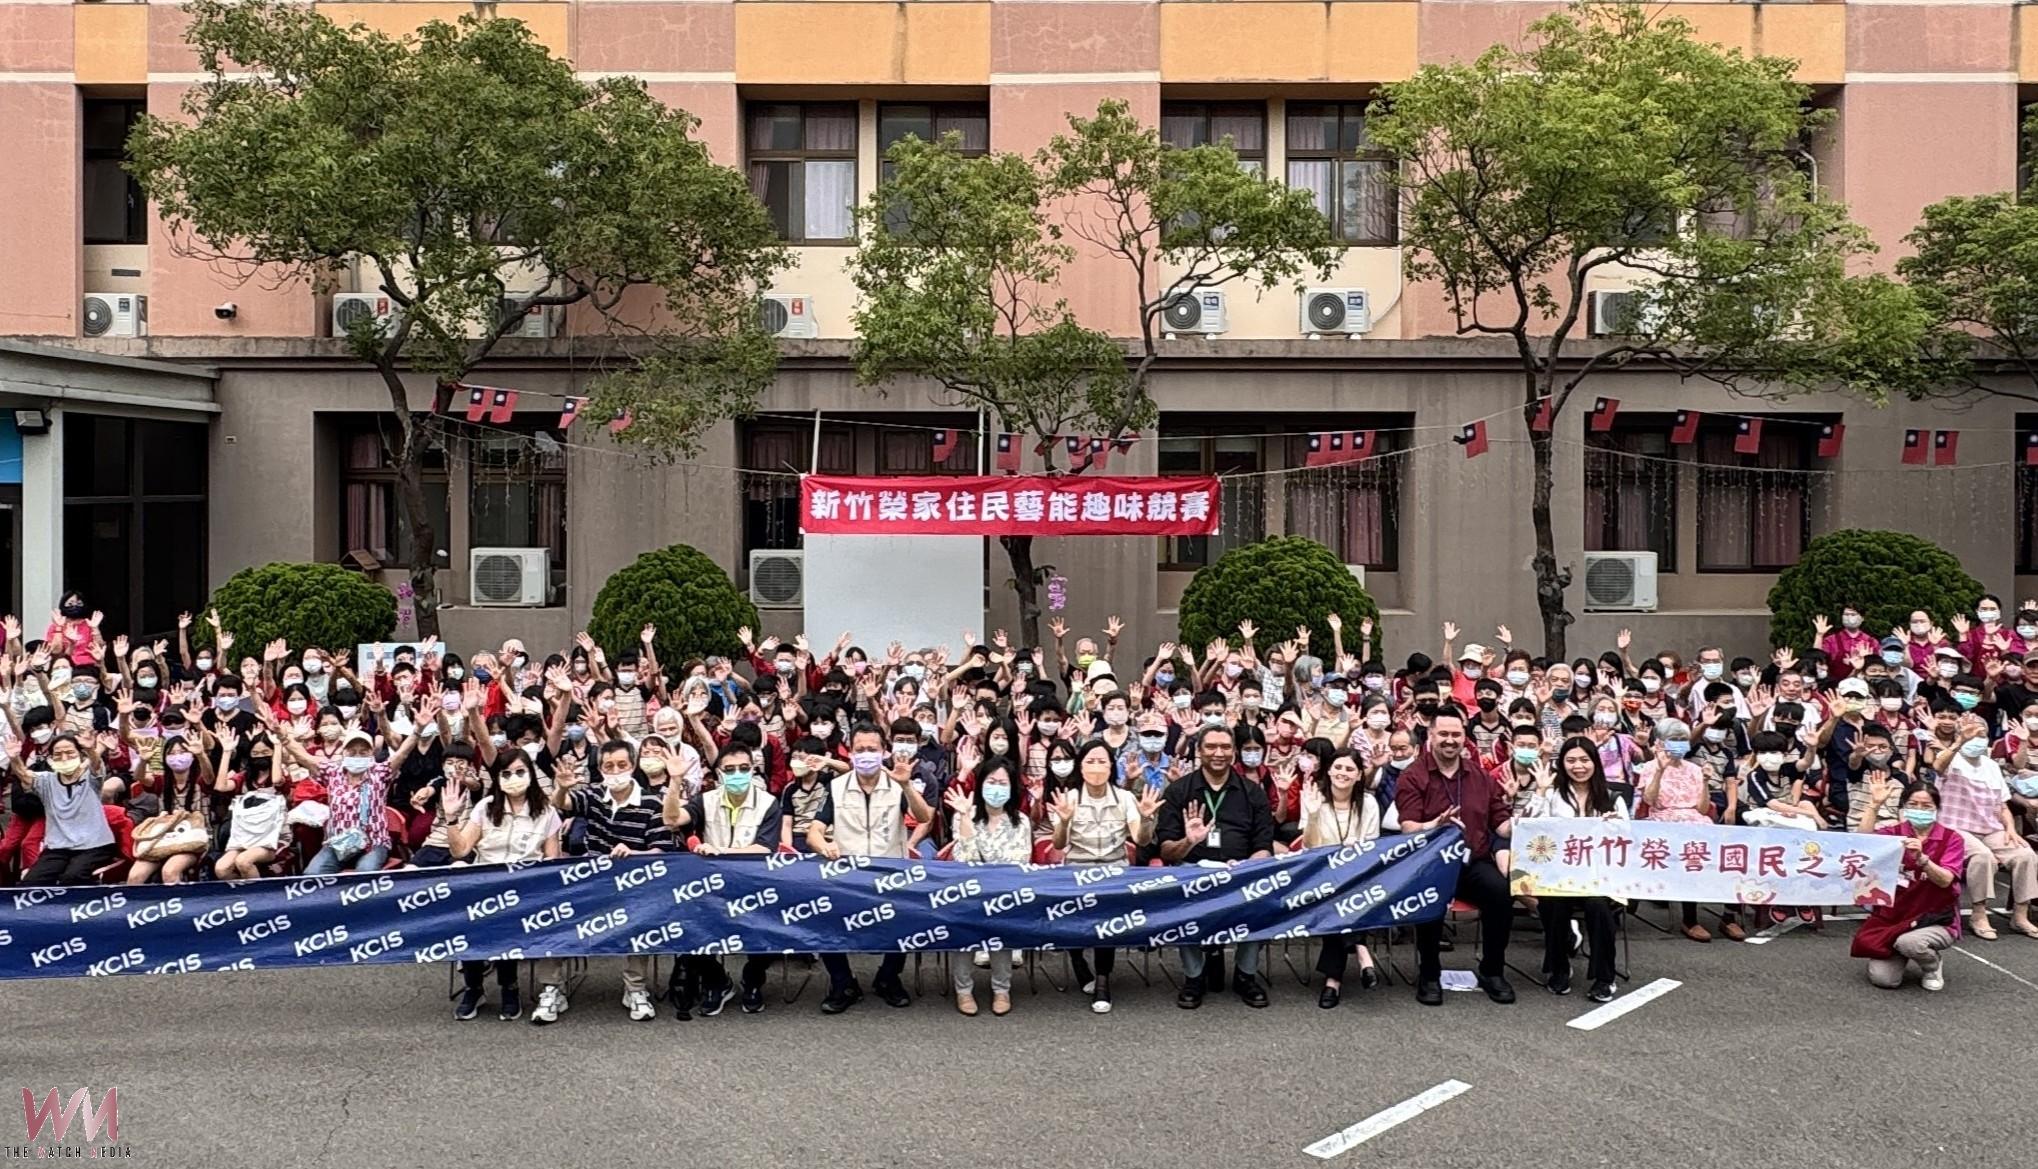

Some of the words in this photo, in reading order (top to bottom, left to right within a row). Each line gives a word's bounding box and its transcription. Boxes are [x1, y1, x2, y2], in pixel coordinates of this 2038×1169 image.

[810, 489, 1210, 522] 新竹榮家住民藝能趣味競賽
[1327, 838, 1376, 870] KCIS
[1379, 833, 1428, 865] KCIS
[1562, 833, 1872, 881] 新竹榮譽國民之家
[559, 854, 613, 885] KCIS
[614, 860, 668, 892] KCIS
[819, 855, 872, 879] KCIS
[874, 865, 927, 894] KCIS
[1073, 864, 1124, 886] KCIS
[13, 887, 67, 910] KCIS
[284, 876, 338, 900] KCIS
[340, 875, 394, 906] KCIS
[397, 882, 451, 913] KCIS
[672, 873, 725, 904] KCIS
[928, 879, 981, 909] KCIS
[1181, 870, 1232, 899] KCIS
[1241, 870, 1292, 901] KCIS
[1286, 882, 1336, 911] KCIS
[70, 892, 127, 923] KCIS
[126, 897, 183, 929] KCIS
[193, 901, 249, 932] KCIS
[466, 889, 520, 921] KCIS
[726, 887, 779, 918] KCIS
[780, 895, 833, 925] KCIS
[982, 887, 1036, 917] KCIS
[1045, 892, 1098, 921] KCIS
[1335, 884, 1387, 918] KCIS
[1390, 886, 1440, 921] KCIS
[237, 914, 291, 945] KCIS
[521, 901, 575, 933] KCIS
[575, 908, 628, 940] KCIS
[843, 903, 896, 932] KCIS
[1094, 909, 1147, 940] KCIS
[294, 925, 349, 957] KCIS
[349, 930, 404, 963] KCIS
[415, 935, 469, 964] KCIS
[630, 921, 684, 953] KCIS
[897, 925, 950, 953] KCIS
[1149, 921, 1199, 948] KCIS
[31, 937, 87, 967] KCIS
[88, 948, 145, 976] KCIS
